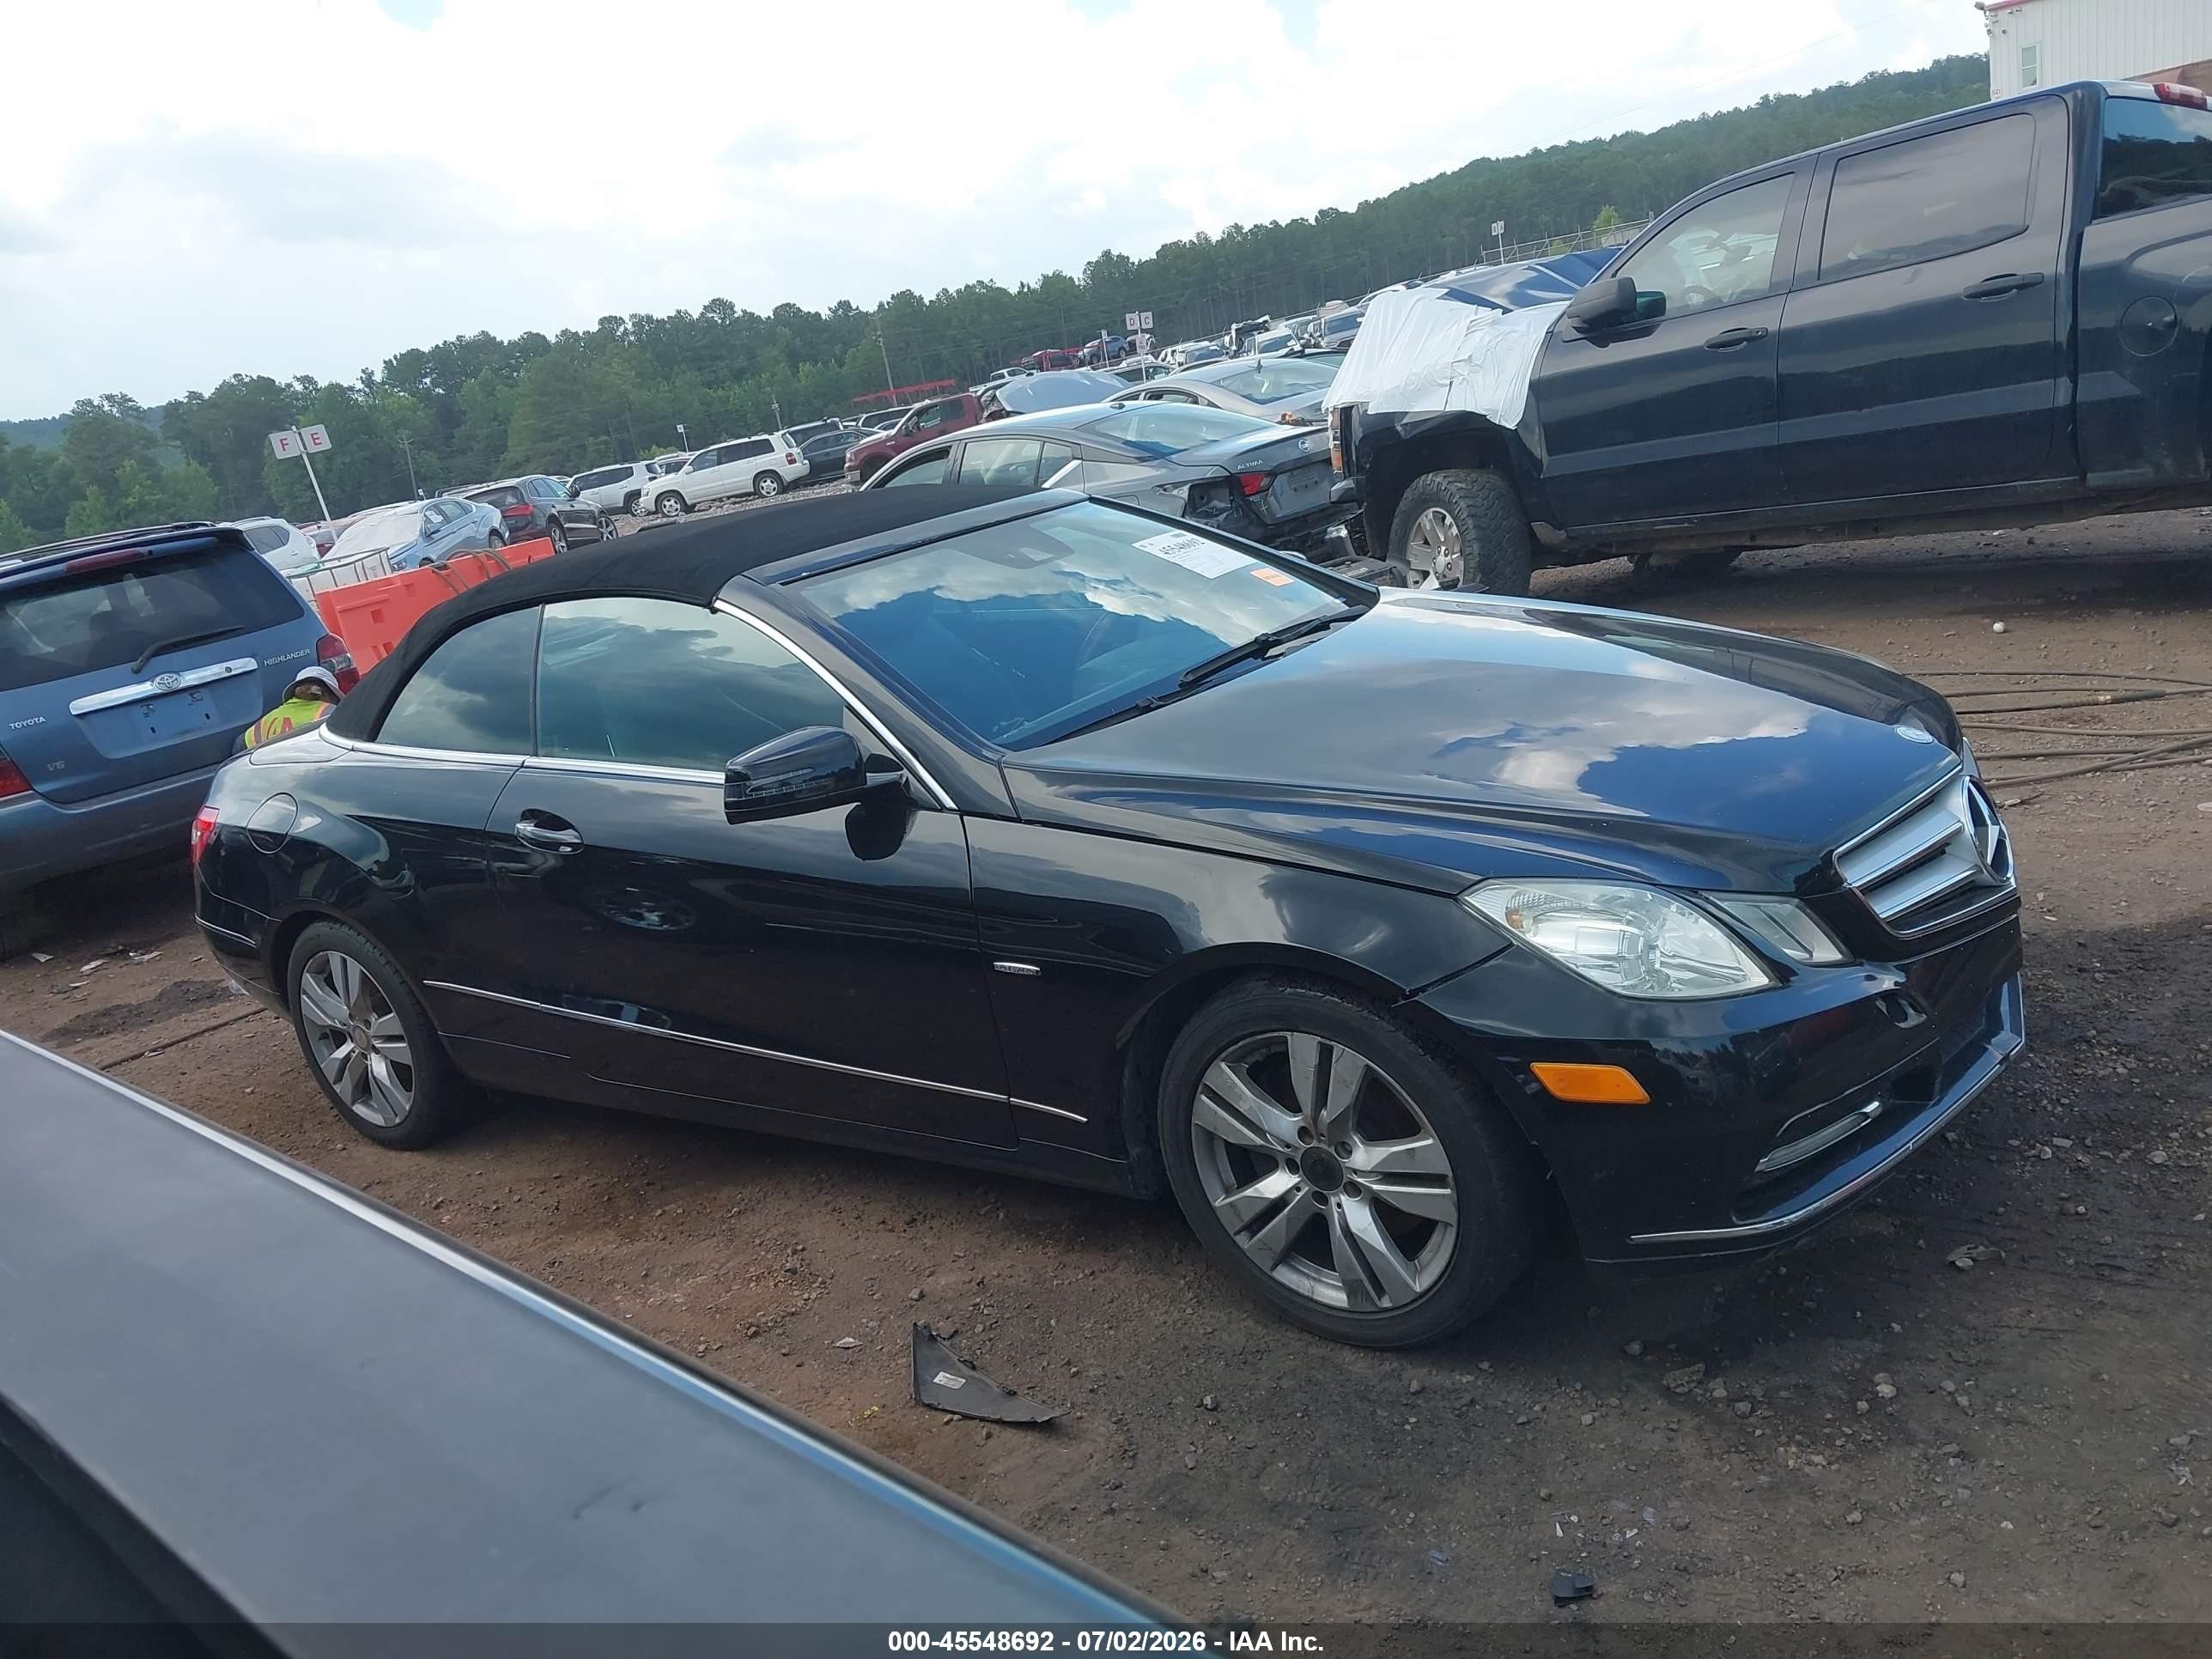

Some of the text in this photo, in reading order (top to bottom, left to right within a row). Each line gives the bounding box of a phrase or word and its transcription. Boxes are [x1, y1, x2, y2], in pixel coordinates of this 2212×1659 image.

[1129, 318, 1135, 326] D
[1144, 316, 1151, 325] C
[279, 437, 289, 452] F
[310, 432, 323, 446] E
[1237, 459, 1263, 470] ALTIMA
[263, 648, 310, 666] HIGHLANDER
[9, 716, 47, 730] TOYOTA
[46, 761, 65, 771] V6
